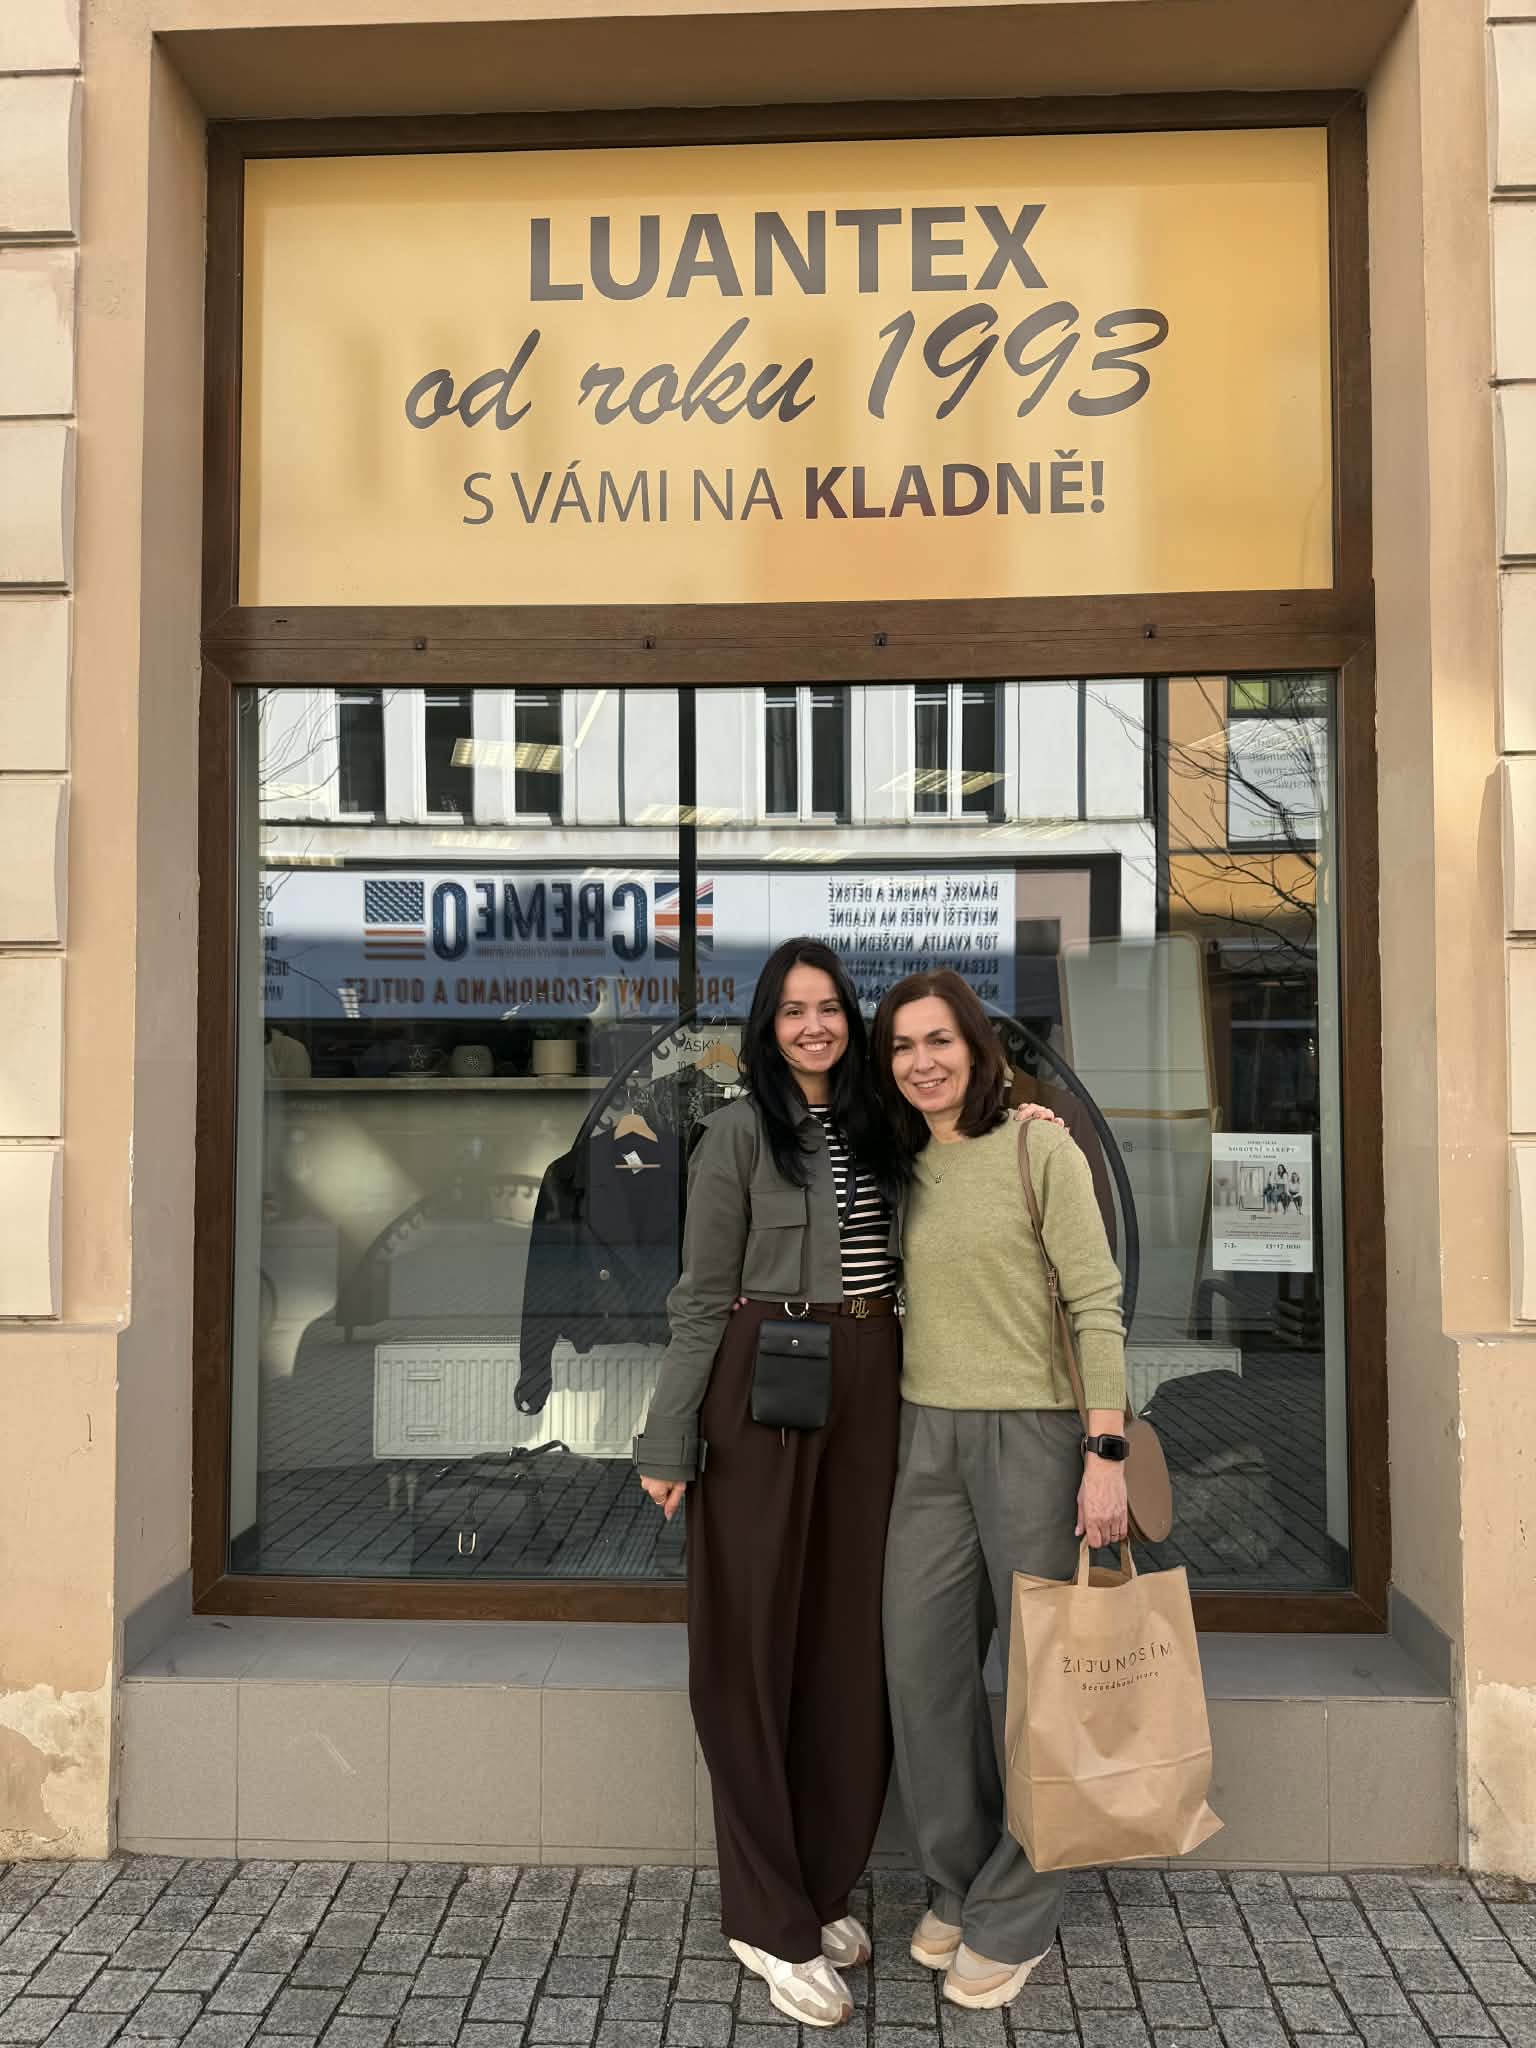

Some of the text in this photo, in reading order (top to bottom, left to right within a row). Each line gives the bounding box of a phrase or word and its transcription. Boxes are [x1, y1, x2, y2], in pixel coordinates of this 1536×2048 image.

[530, 204, 1048, 302] LUANTEX
[405, 301, 1169, 430] od roku 1993
[463, 449, 1105, 525] S VÁMI NA KLADNĚ!
